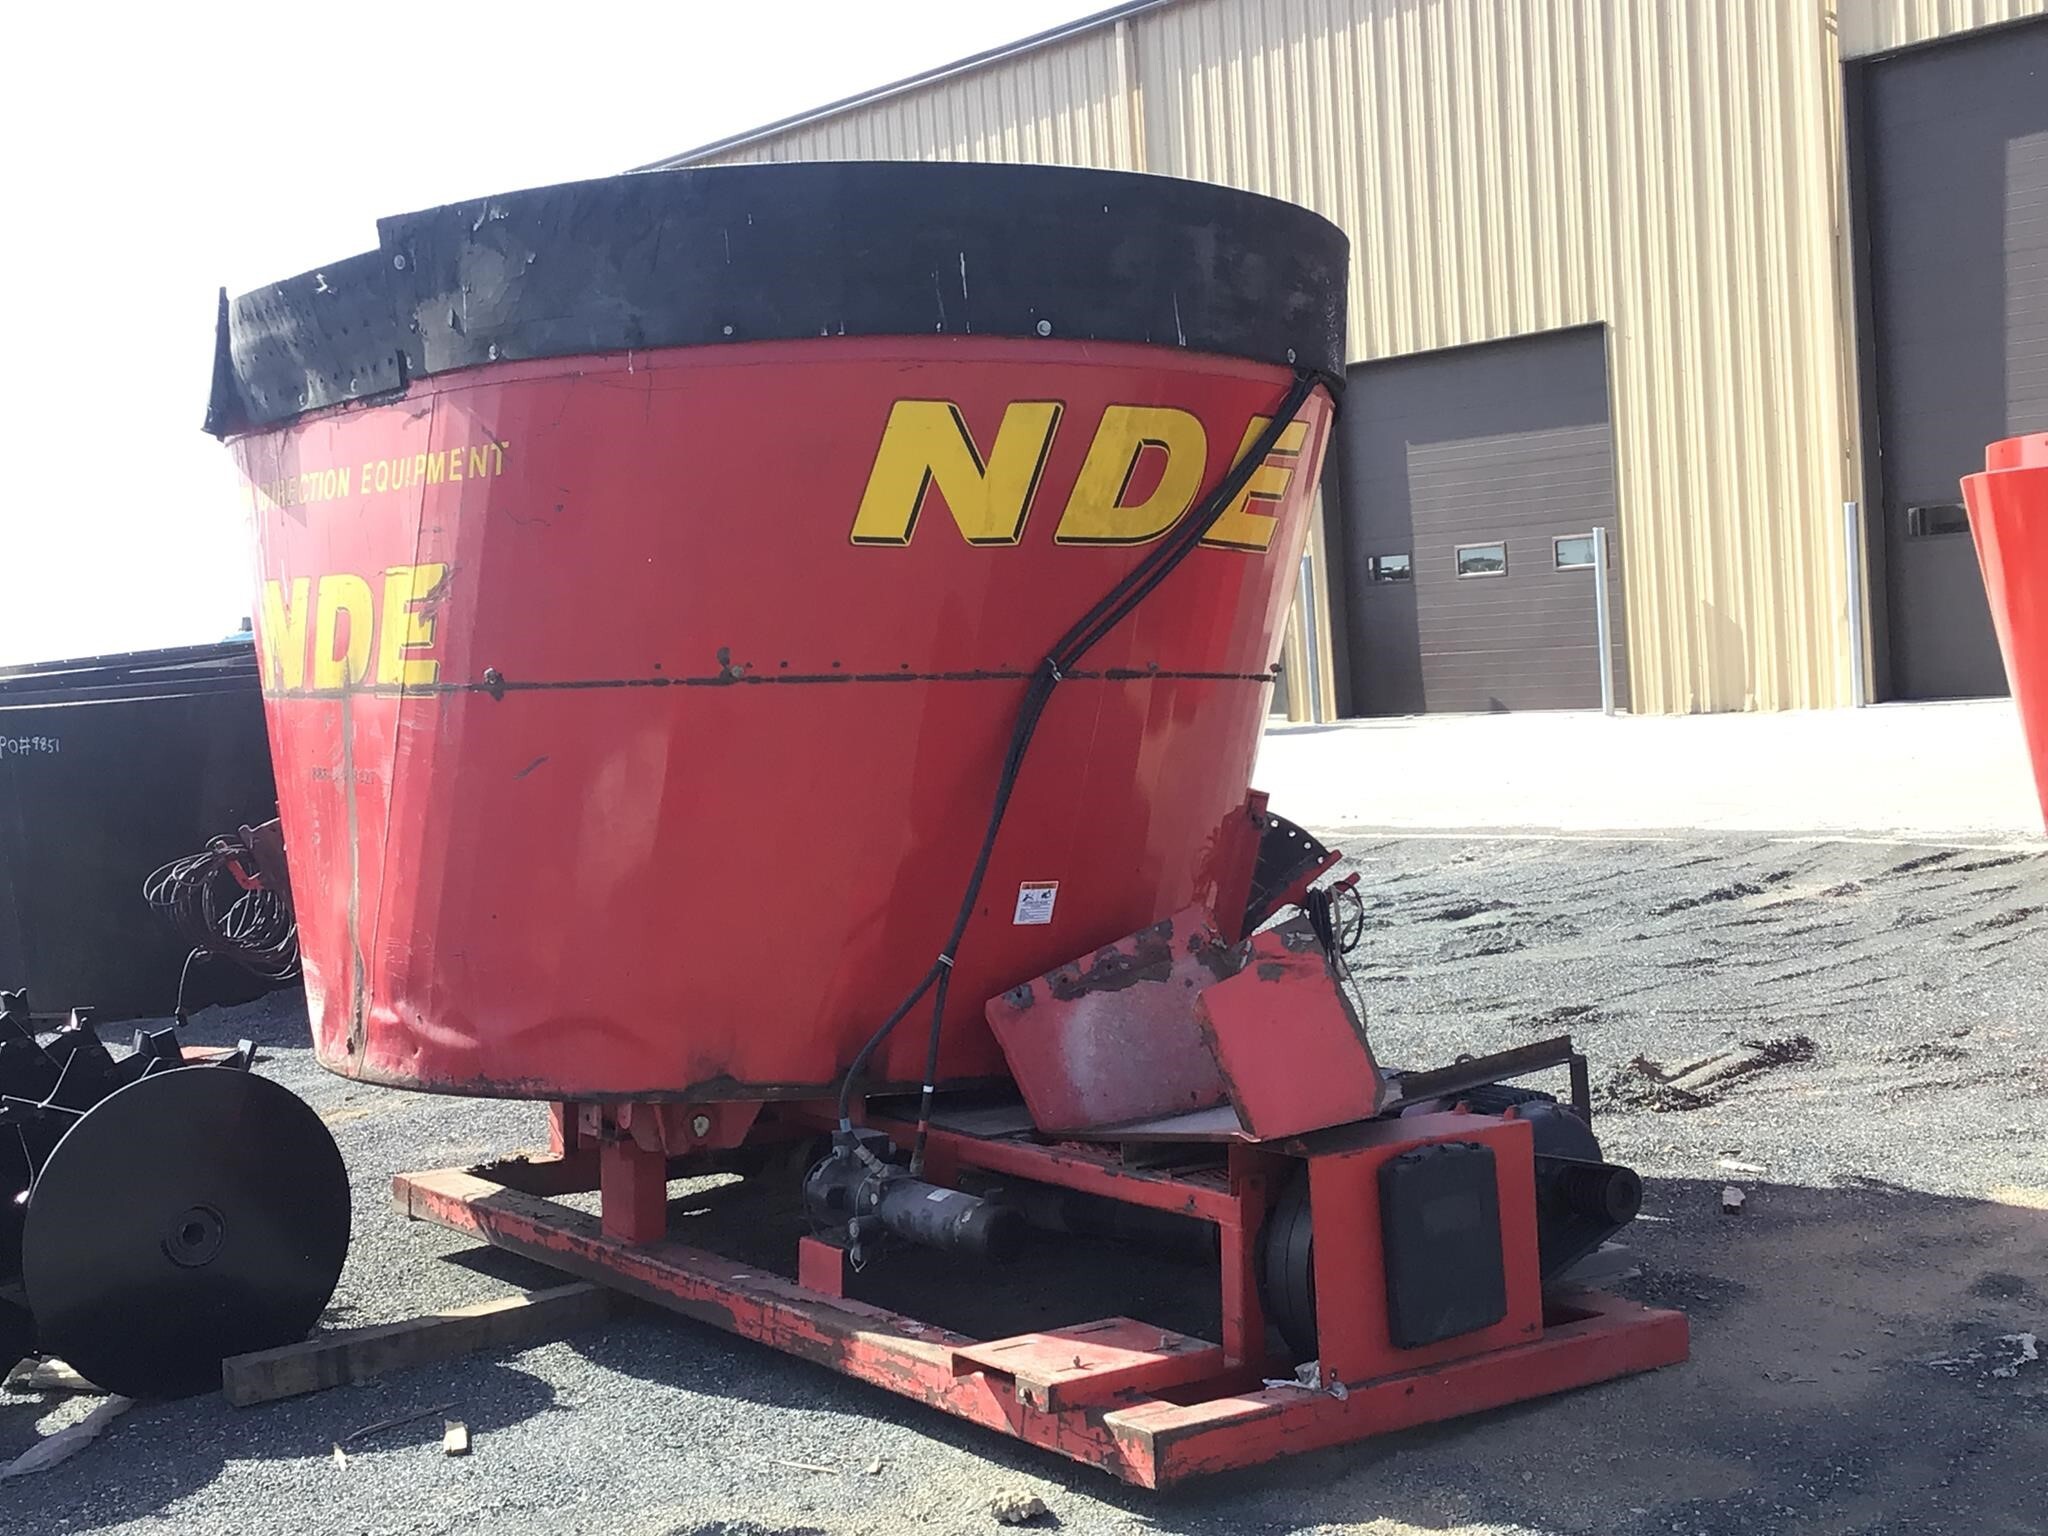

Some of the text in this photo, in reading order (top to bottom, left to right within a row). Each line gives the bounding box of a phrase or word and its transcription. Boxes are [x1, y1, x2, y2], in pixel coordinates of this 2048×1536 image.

[360, 441, 510, 495] EQUIPMENT
[850, 398, 1310, 553] NDE
[263, 561, 449, 698] NDE
